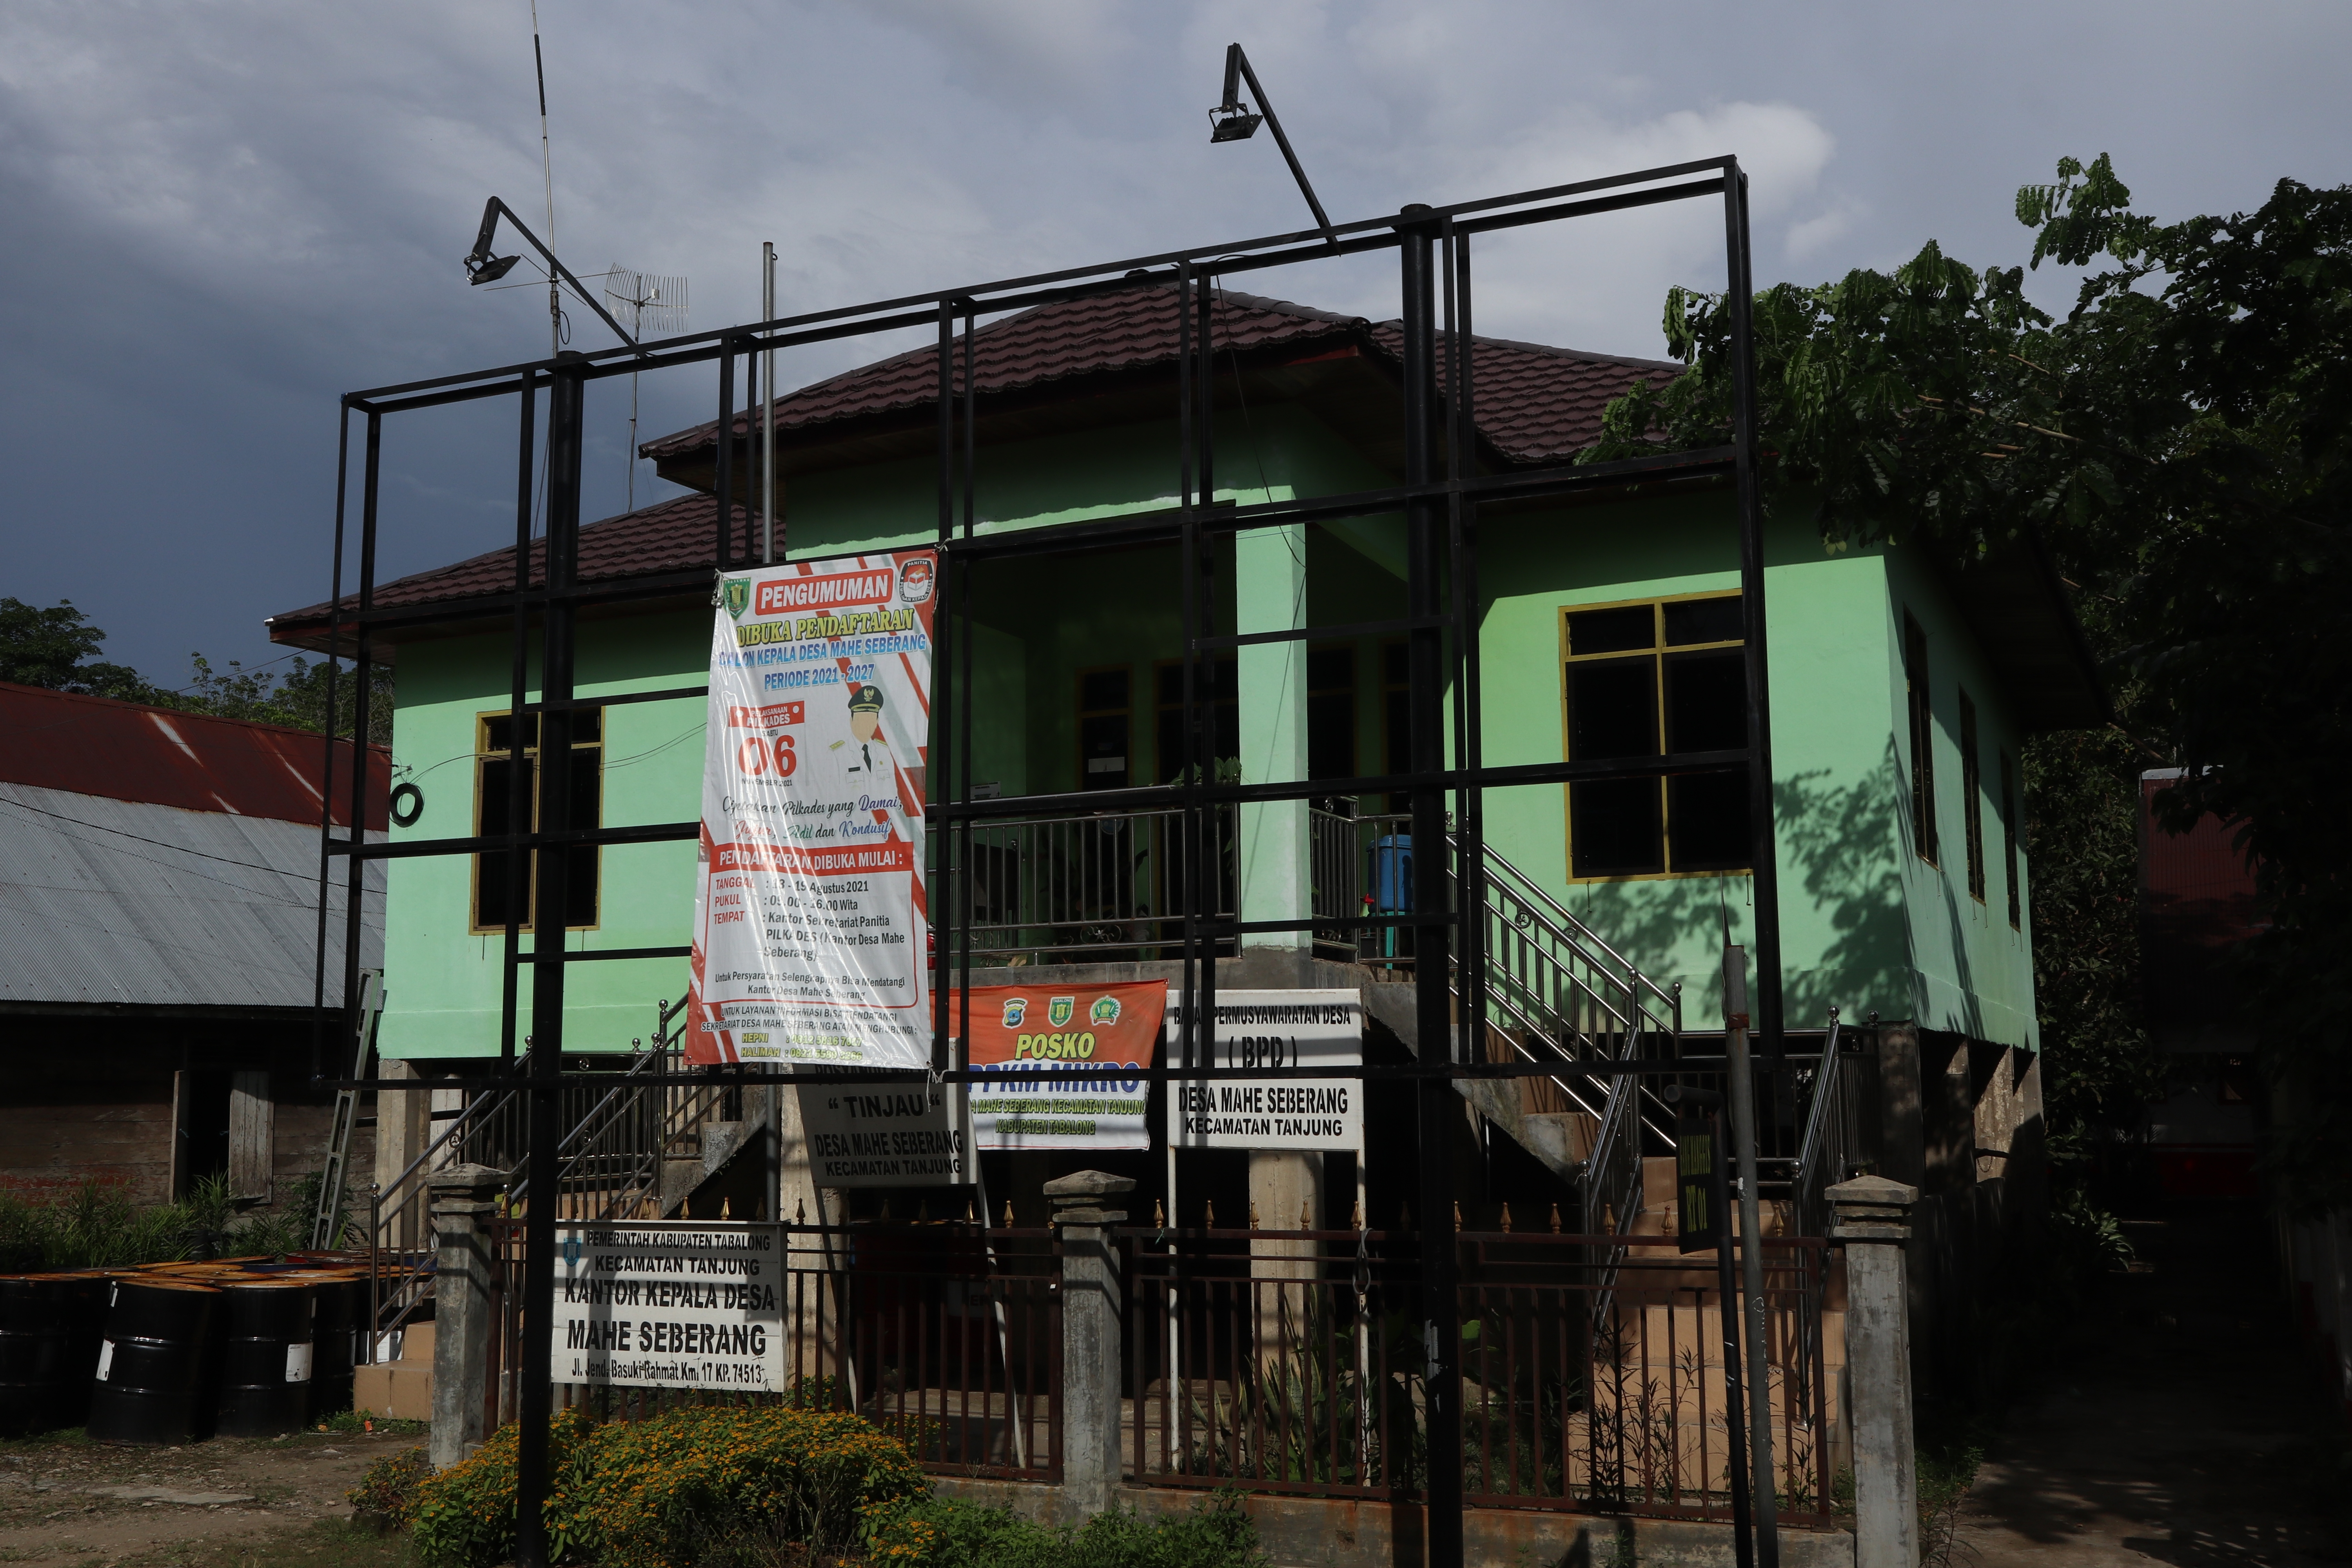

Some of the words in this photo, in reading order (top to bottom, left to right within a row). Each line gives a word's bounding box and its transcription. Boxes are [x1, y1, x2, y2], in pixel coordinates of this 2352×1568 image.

[761, 575, 888, 609] PENGUMUMAN
[736, 620, 792, 647] DIBUKA
[795, 608, 915, 641] PENDAFTARAN
[719, 650, 755, 668] CALON
[757, 646, 796, 666] KEPALA
[799, 643, 827, 661] DESA
[830, 639, 862, 658] MAHE
[864, 633, 926, 655] SEBERANG
[764, 670, 809, 690] PERIODE
[812, 667, 838, 685] 2021
[847, 663, 875, 682] 2027
[747, 713, 790, 727] PILKADES
[751, 706, 788, 717] PELAKSANAAN
[738, 735, 797, 777] 06
[784, 799, 824, 816] Pilkades
[828, 800, 854, 818] yang
[858, 794, 902, 811] Damai,
[783, 824, 812, 839] Adil
[815, 823, 835, 838] dan
[839, 817, 892, 840] Kondusif
[720, 851, 811, 870] PENDAFTARAN
[814, 853, 856, 870] DIBUKA
[858, 850, 895, 867] MULAI
[716, 877, 756, 890] TANGGAL
[809, 882, 845, 896] Agustus
[847, 880, 869, 893] 2021
[715, 894, 741, 907] PUKUL
[840, 900, 858, 911] Wita
[714, 911, 745, 924] TEMPAT
[769, 913, 802, 925] Kantor
[806, 914, 858, 928] Sekretariat
[860, 915, 889, 927] Panitia
[766, 929, 817, 942] PILKADES
[858, 933, 878, 945] Desa
[882, 932, 905, 944] Mahe
[764, 946, 817, 962] Seberang)
[715, 972, 731, 983] Untuk
[732, 971, 779, 982] Persyaratan
[782, 972, 839, 985] Selengkapnya
[842, 975, 860, 985] Bisa
[862, 977, 905, 988] Mendatangi
[748, 985, 775, 995] Kantor
[777, 986, 797, 996] Desa
[800, 987, 823, 996] Mahe
[721, 1006, 740, 1016] UNTUK
[742, 1006, 775, 1014] LAYANAN
[777, 1007, 822, 1017] INFORMASI
[824, 1008, 842, 1018] BISA
[1323, 1005, 1351, 1025] DESA
[701, 1019, 740, 1031] SEKRETARIAT
[741, 1019, 761, 1027] DESA
[763, 1019, 785, 1028] MAHE
[787, 1020, 831, 1030] SEBERANG
[832, 1022, 852, 1031] ATAU
[742, 1033, 768, 1043] HEPNI
[1015, 1032, 1096, 1061] POSKO
[740, 1047, 780, 1058] HALIMAH
[789, 1047, 813, 1058] 0821
[1242, 1036, 1284, 1068] BPD
[844, 1094, 924, 1118] TINJAU
[977, 1099, 1003, 1113] MAHE
[1003, 1099, 1050, 1113] SEBERANG
[1051, 1099, 1105, 1114] KECAMATAN
[1178, 1087, 1217, 1112] DESA
[1221, 1087, 1262, 1114] MAHE
[1267, 1087, 1348, 1114] SEBERANG
[995, 1119, 1048, 1134] KABUPATEN
[1049, 1120, 1096, 1135] TABALONG
[1185, 1117, 1270, 1136] KECAMATAN
[1275, 1119, 1342, 1136] TANJUNG
[814, 1133, 851, 1158] DESA
[852, 1132, 890, 1157] MAHE
[893, 1129, 964, 1155] SEBERANG
[825, 1160, 900, 1177] KECAMATAN
[902, 1158, 962, 1175] TANJUNG
[587, 1230, 649, 1249] PEMERINTAH
[652, 1232, 711, 1250] KABUPATEN
[714, 1234, 770, 1251] TABALONG
[595, 1255, 683, 1272] KECAMATAN
[688, 1256, 760, 1276] TANJUNG
[564, 1278, 640, 1306] KANTOR
[646, 1281, 718, 1309] KEPALA
[724, 1283, 775, 1311] DESA
[567, 1319, 631, 1351] MAHE
[639, 1321, 766, 1356] SEBERANG
[572, 1358, 582, 1377] Jl.
[585, 1358, 608, 1378] Jend.
[611, 1359, 641, 1379] Basuki
[644, 1360, 679, 1381] Rahmat
[701, 1362, 712, 1382] 17
[716, 1363, 730, 1383] KP.
[733, 1363, 761, 1384] 71513
